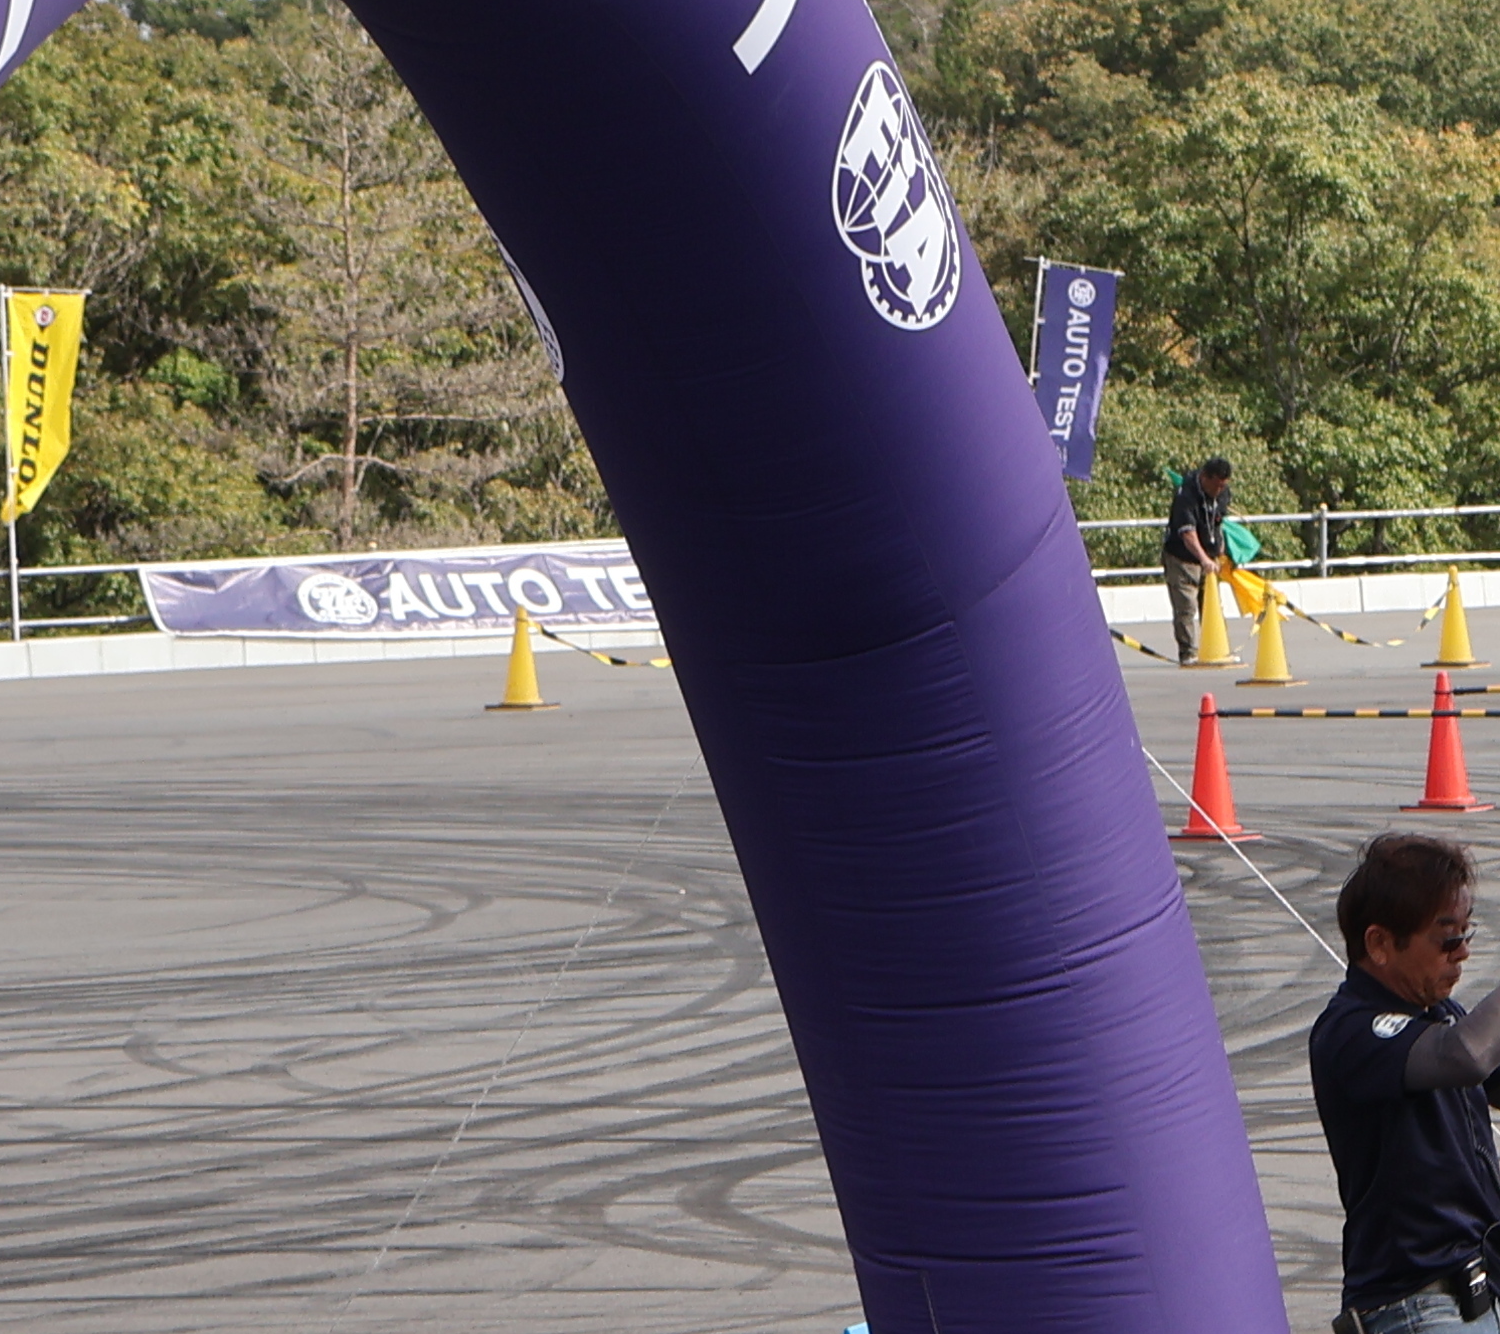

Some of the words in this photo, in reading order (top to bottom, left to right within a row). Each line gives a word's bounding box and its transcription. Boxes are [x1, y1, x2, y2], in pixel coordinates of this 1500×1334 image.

[1062, 307, 1091, 378] AUTO
[1050, 382, 1082, 441] TEST
[388, 567, 564, 622] AUTO
[568, 565, 654, 611] TE
